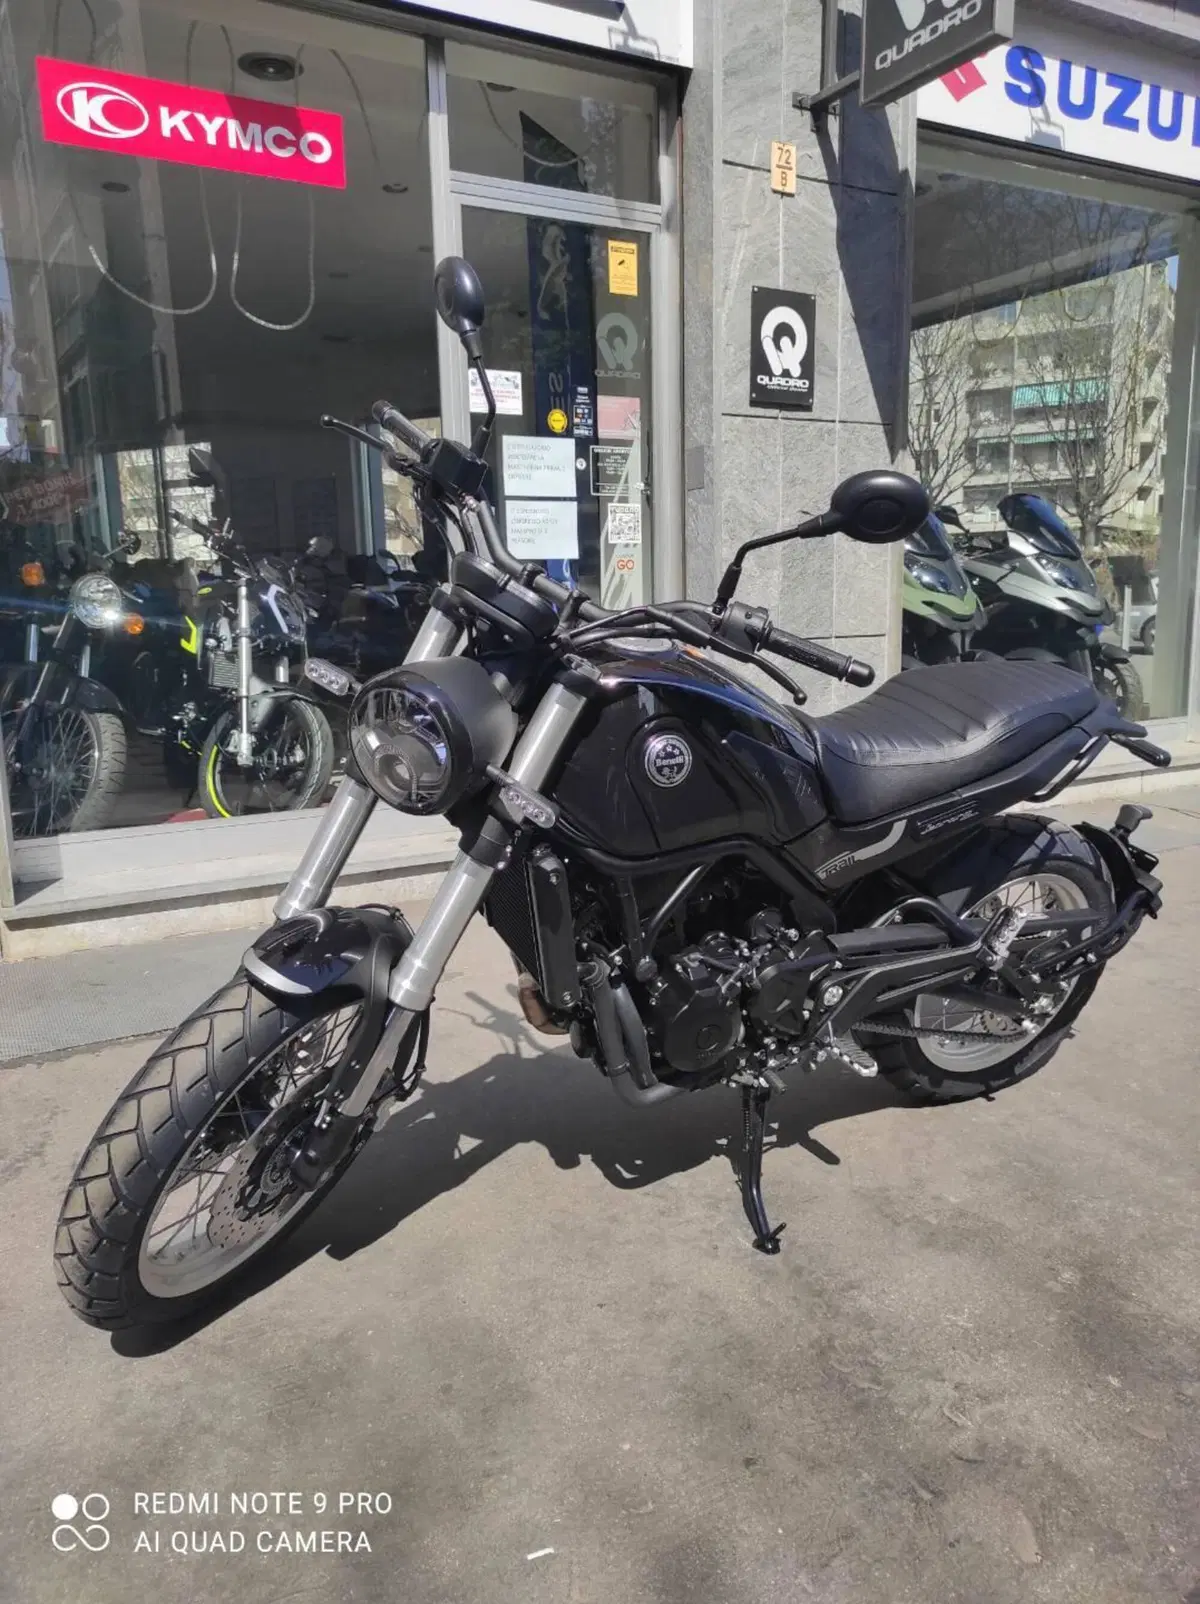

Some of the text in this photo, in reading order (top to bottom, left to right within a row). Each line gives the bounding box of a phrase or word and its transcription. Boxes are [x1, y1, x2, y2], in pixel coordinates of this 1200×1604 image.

[875, 0, 982, 71] QUADRO
[1003, 45, 1200, 148] SUZU
[159, 105, 333, 164] KYMCO
[777, 146, 792, 165] 72
[780, 170, 788, 187] B
[757, 375, 809, 388] QUADRO
[616, 559, 635, 570] GO
[655, 755, 685, 767] Benelli
